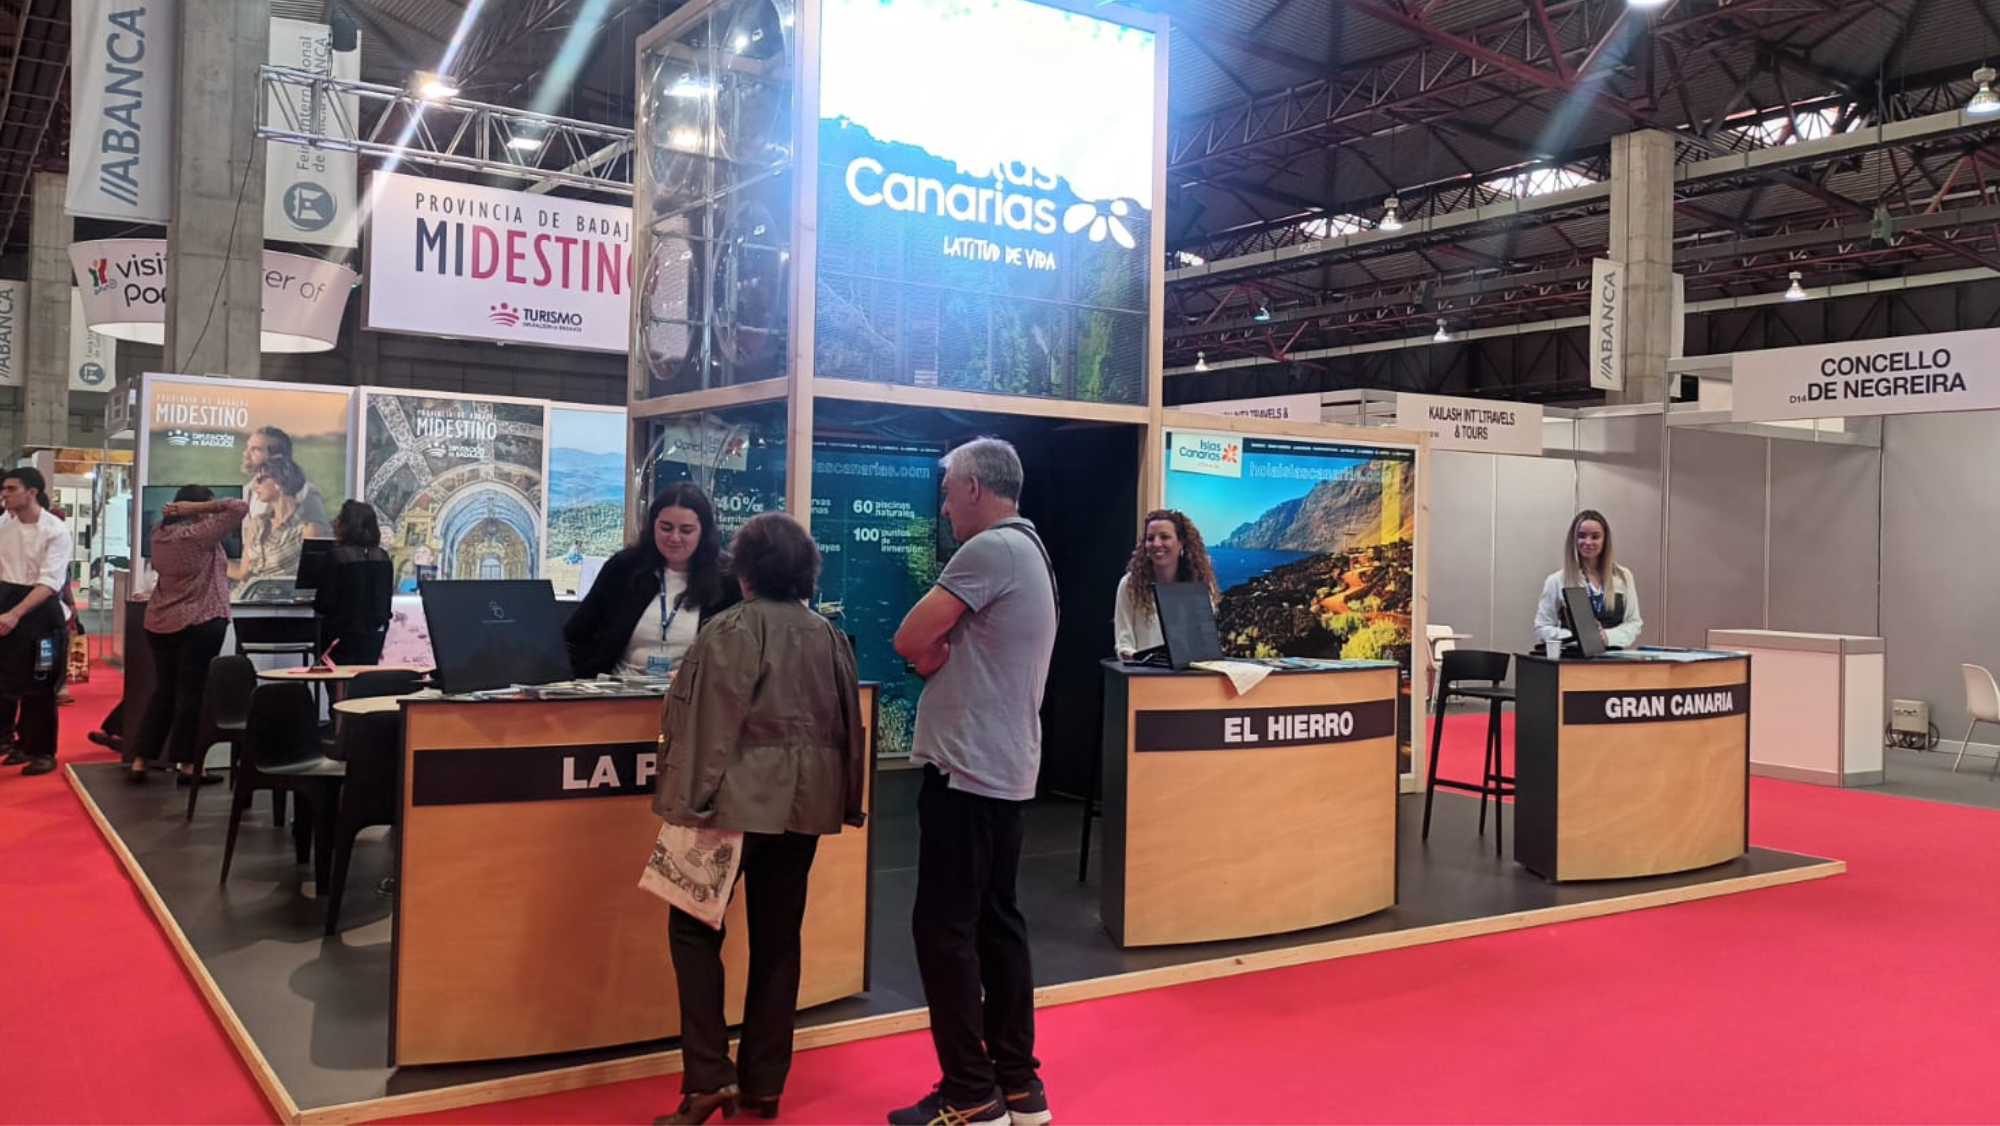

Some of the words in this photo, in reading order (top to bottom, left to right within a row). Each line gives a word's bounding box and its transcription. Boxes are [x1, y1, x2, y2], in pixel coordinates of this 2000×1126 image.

[845, 156, 1057, 234] Canarias
[415, 192, 522, 223] PROVINCIA
[538, 210, 560, 229] DE
[576, 215, 629, 242] BADAJ
[115, 252, 167, 279] visi
[415, 217, 632, 295] MIDESTIN
[943, 235, 1001, 263] LATITUD
[1005, 245, 1022, 266] DE
[1025, 248, 1057, 271] VIDA
[300, 282, 327, 302] of
[523, 308, 583, 326] TURISMO
[1820, 348, 1951, 377] CONCELLO
[1807, 381, 1838, 401] DE
[1844, 372, 1967, 399] NEGREIRA
[156, 402, 249, 428] MIDESTINO
[1429, 405, 1462, 421] KAILASH
[416, 417, 498, 441] MIDESTINO
[1462, 425, 1489, 440] TOURS
[1179, 446, 1221, 461] Canarias
[1200, 438, 1222, 451] Islas
[852, 499, 873, 514] 60
[853, 527, 880, 541] 100
[1605, 696, 1665, 719] GRAN
[1670, 691, 1733, 716] CANARIA
[1224, 716, 1259, 743] EL
[1268, 710, 1354, 741] HIERRO
[563, 755, 621, 790] LA
